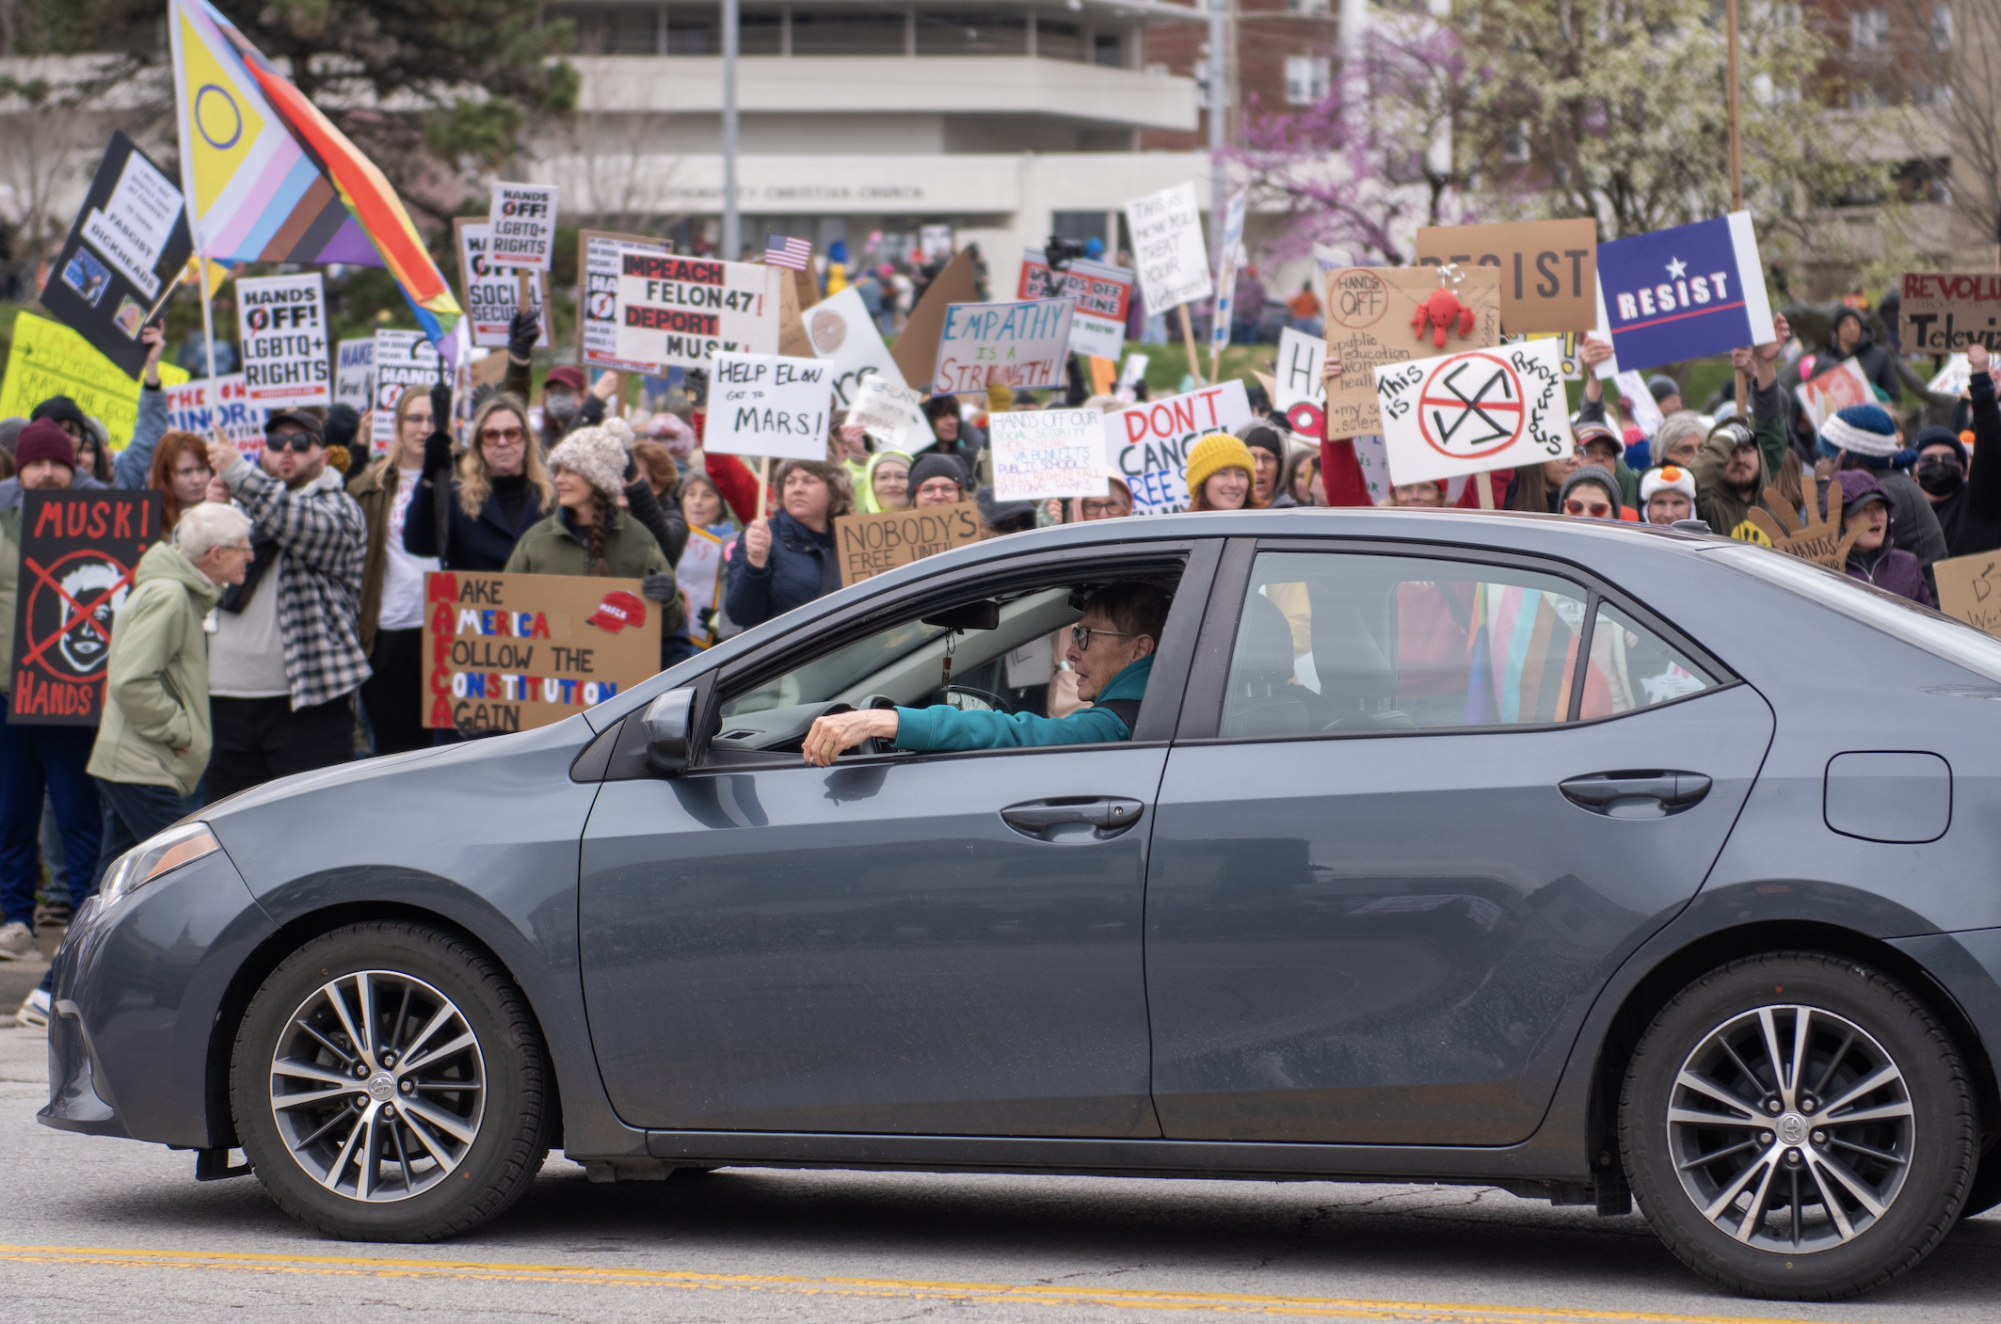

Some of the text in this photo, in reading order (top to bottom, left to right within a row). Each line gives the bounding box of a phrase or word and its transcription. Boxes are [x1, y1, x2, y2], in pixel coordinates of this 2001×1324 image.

[502, 190, 549, 201] HANDS
[1134, 193, 1184, 219] THIS IS
[502, 201, 548, 218] OFF!
[109, 211, 155, 258] FASCIST
[495, 221, 548, 237] LGBTQ+
[1136, 208, 1195, 242] HOW YOU
[90, 223, 155, 290] DICKHEADS
[494, 237, 546, 254] RIGHTS
[1141, 232, 1183, 263] TREAT
[623, 254, 724, 285] IMPEACH
[1144, 257, 1182, 283] YOUR
[1420, 250, 1589, 300] IST
[469, 284, 542, 306] SOCIL
[1092, 281, 1121, 299] OFF
[1338, 275, 1380, 291] HANDS
[244, 287, 317, 305] HANDS
[1340, 291, 1384, 317] OFF
[1617, 271, 1728, 321] RESIST
[247, 304, 319, 330] OFF!
[625, 305, 719, 336] DEPORT
[943, 303, 1066, 341] EMPATHY
[1085, 320, 1116, 336] NOW
[243, 335, 325, 360] LGBTQ+
[976, 346, 1016, 360] IS A
[1337, 333, 1377, 358] public
[1344, 346, 1410, 361] education
[246, 360, 328, 386] RIGHTS
[718, 358, 767, 383] HELP
[936, 357, 1054, 393] STRENGTH
[1377, 365, 1424, 400] This
[167, 388, 206, 410] THE
[726, 390, 765, 401] GET TO
[734, 406, 823, 441] MARS!
[991, 411, 1099, 430] HANDS OFF OUR
[1124, 388, 1223, 444] DON'T
[1341, 405, 1361, 421] my
[1342, 417, 1383, 432] scien
[993, 427, 1086, 441] SOCIAL SECURITY
[1001, 437, 1070, 452] HEALTHCARE
[998, 459, 1090, 474] PUBLIC SCHOOLS
[1013, 446, 1091, 462] VA BENEFITS
[996, 474, 1031, 485] CIVIL
[1033, 469, 1074, 481] RIGHTS
[996, 479, 1093, 495] NATIONAL PARKS
[34, 500, 150, 551] MUSK!
[843, 508, 977, 552] NOBODY'S
[848, 549, 896, 571] FREE
[429, 572, 503, 605] MAKE
[431, 602, 550, 639] AMERICA
[433, 635, 593, 673] FOLLOW THE
[15, 670, 93, 716] HANDS
[430, 665, 617, 706] CONSTITUTION
[431, 696, 520, 731] AGAIN
